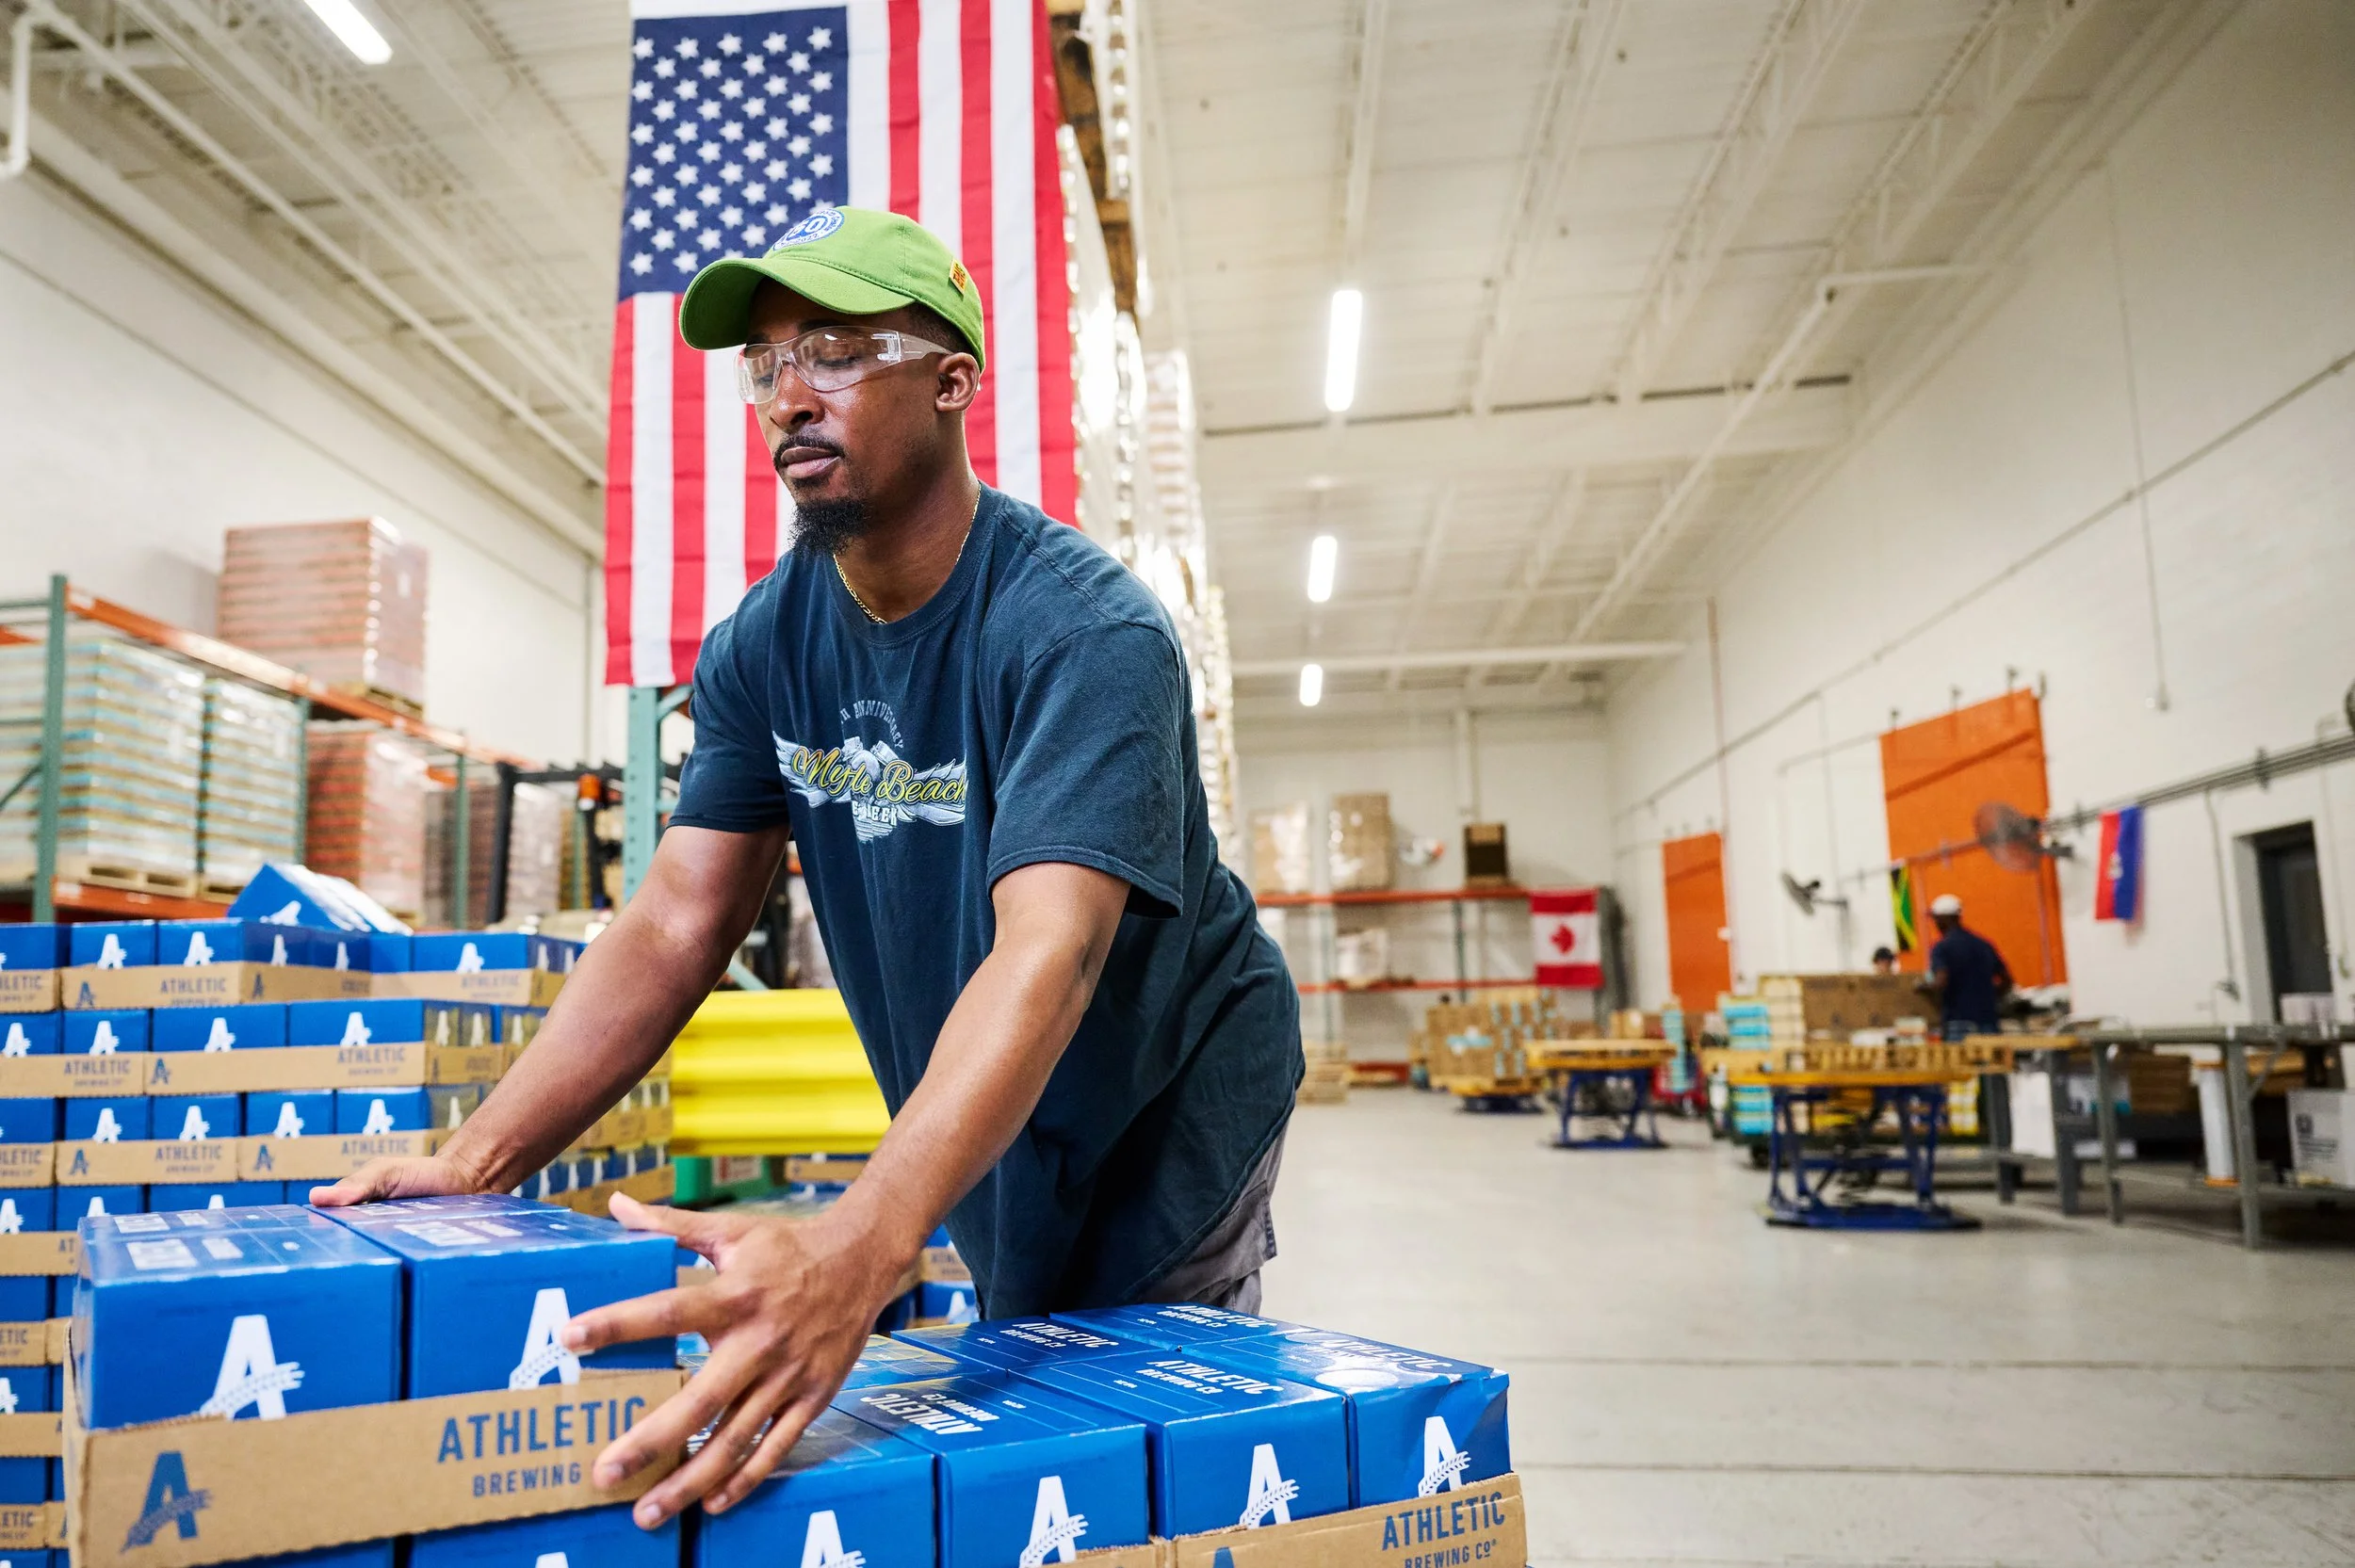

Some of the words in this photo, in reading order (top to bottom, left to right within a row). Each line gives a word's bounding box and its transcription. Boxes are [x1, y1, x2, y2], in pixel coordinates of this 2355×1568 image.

[1012, 1322, 1120, 1348] ATHLETIC
[1166, 1305, 1278, 1328] ATHLETIC
[199, 1315, 305, 1421] A
[1146, 1360, 1284, 1395] ATHLETIC
[437, 1396, 646, 1463] ATHLETIC
[859, 1393, 984, 1435] ATHLETIC
[473, 1463, 582, 1498] BREWING
[1240, 1444, 1300, 1528] A
[1417, 1415, 1472, 1497] A
[120, 1450, 212, 1555] A
[1018, 1476, 1089, 1568] A
[1381, 1491, 1506, 1552] ATHLETIC
